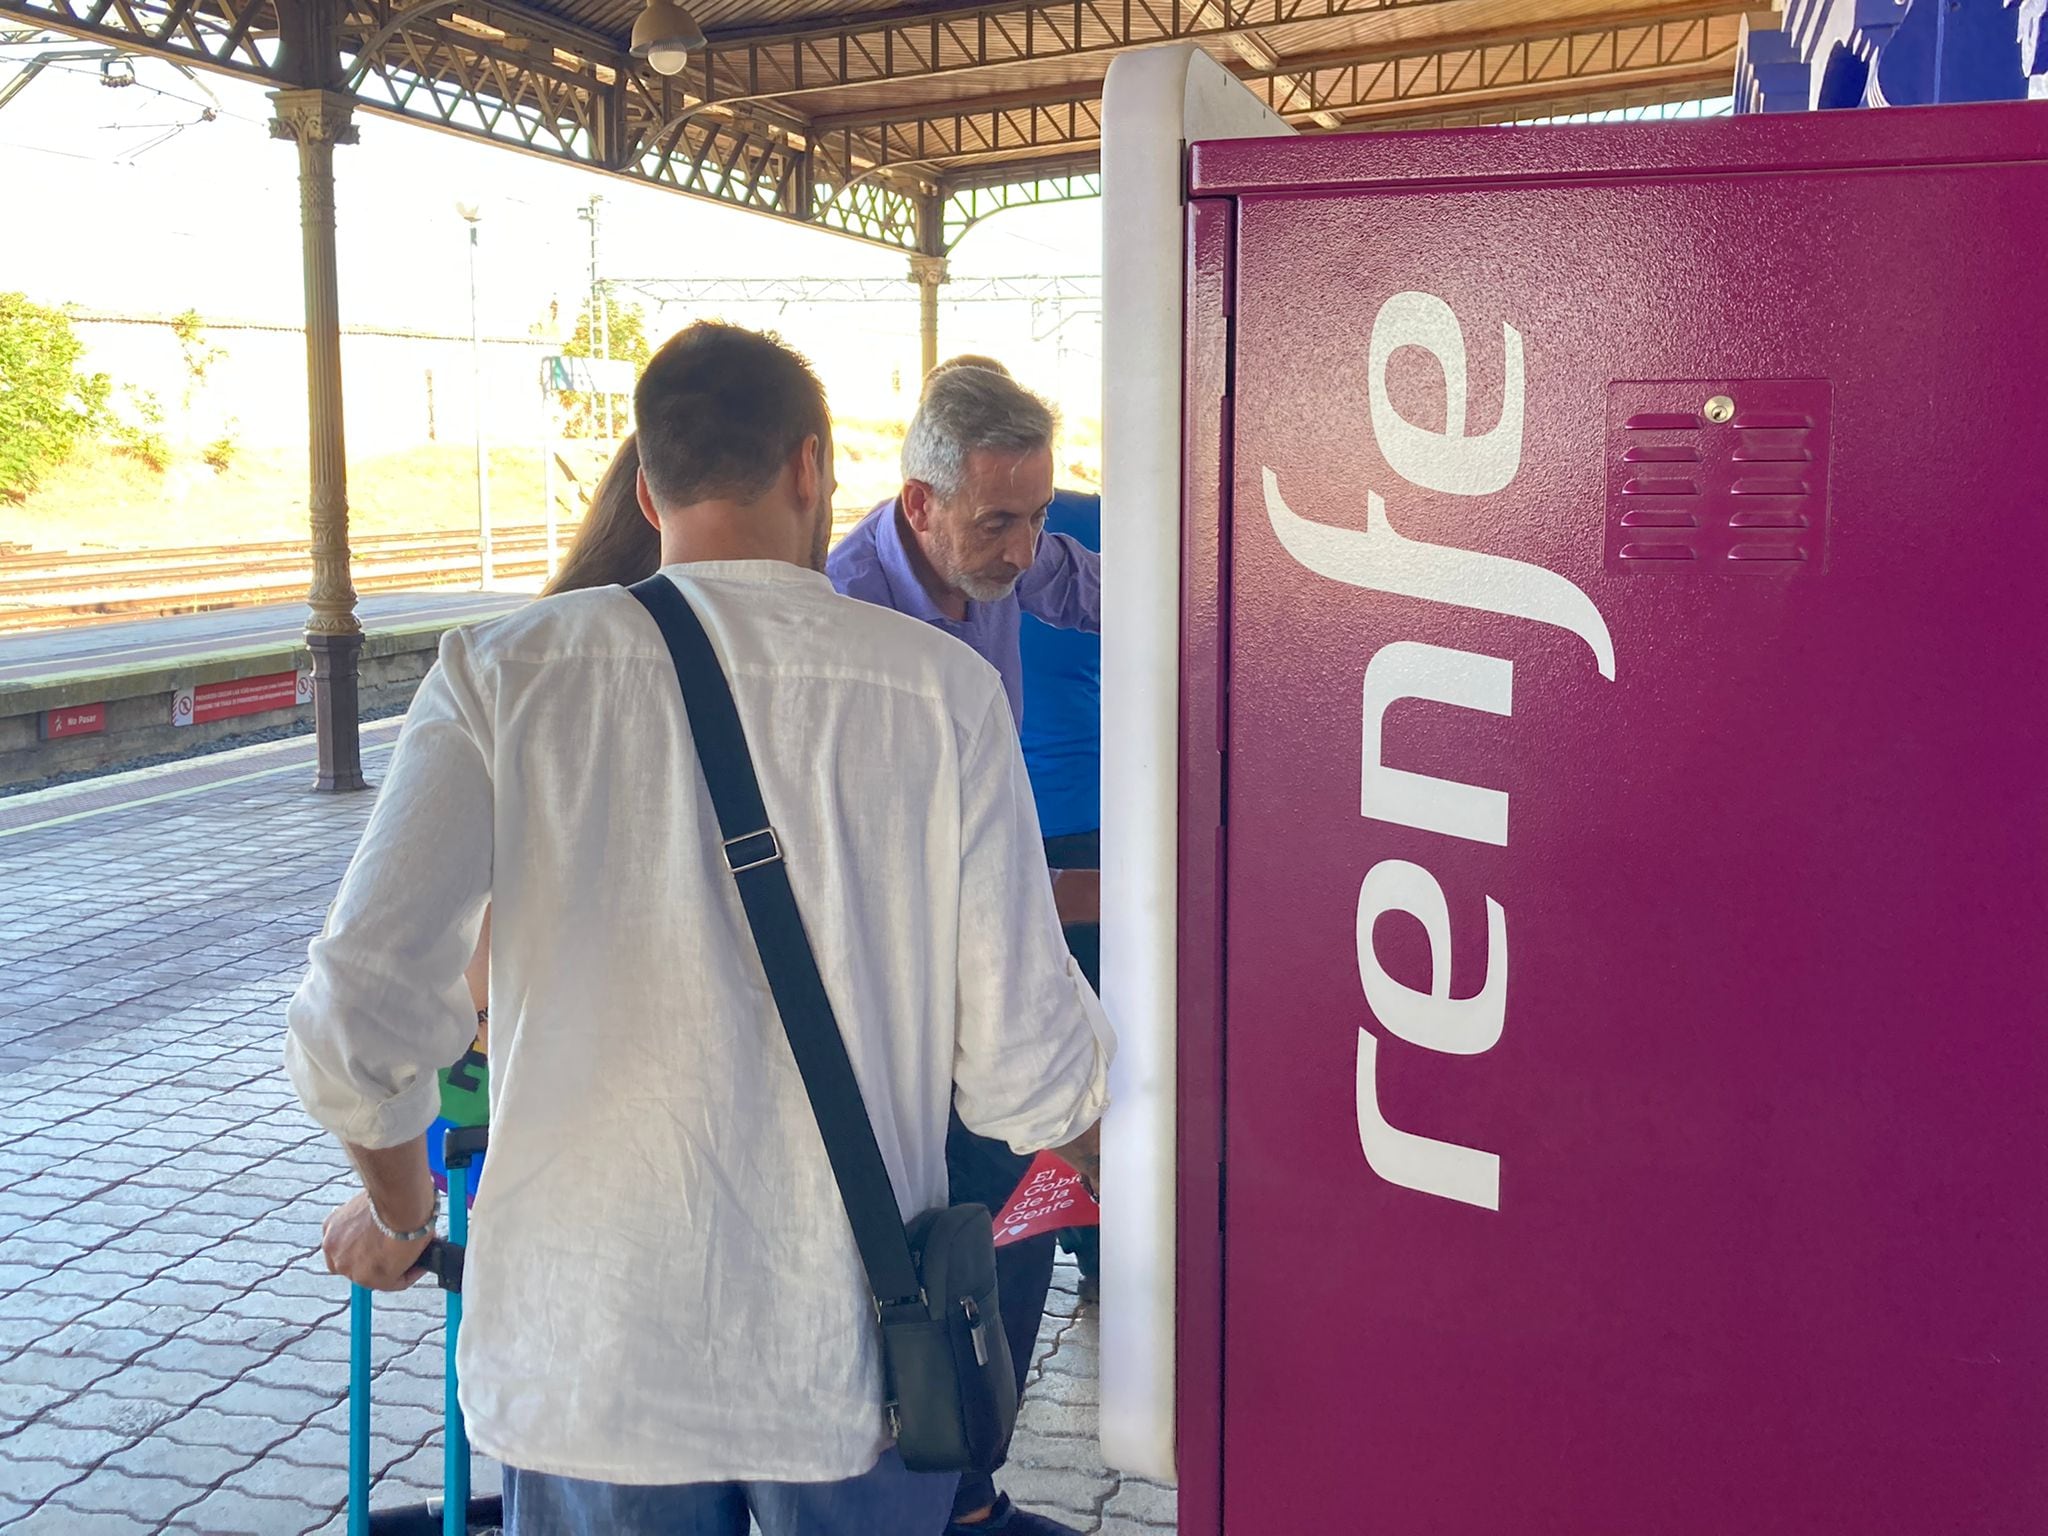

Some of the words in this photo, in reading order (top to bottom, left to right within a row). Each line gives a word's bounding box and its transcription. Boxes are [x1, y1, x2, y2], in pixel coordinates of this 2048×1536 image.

[67, 717, 78, 726] No
[78, 714, 97, 725] Pasar
[1262, 290, 1616, 1211] renfe
[1031, 1169, 1057, 1185] El
[1013, 1197, 1044, 1211] de
[1048, 1188, 1070, 1202] la
[1004, 1199, 1075, 1224] Gente
